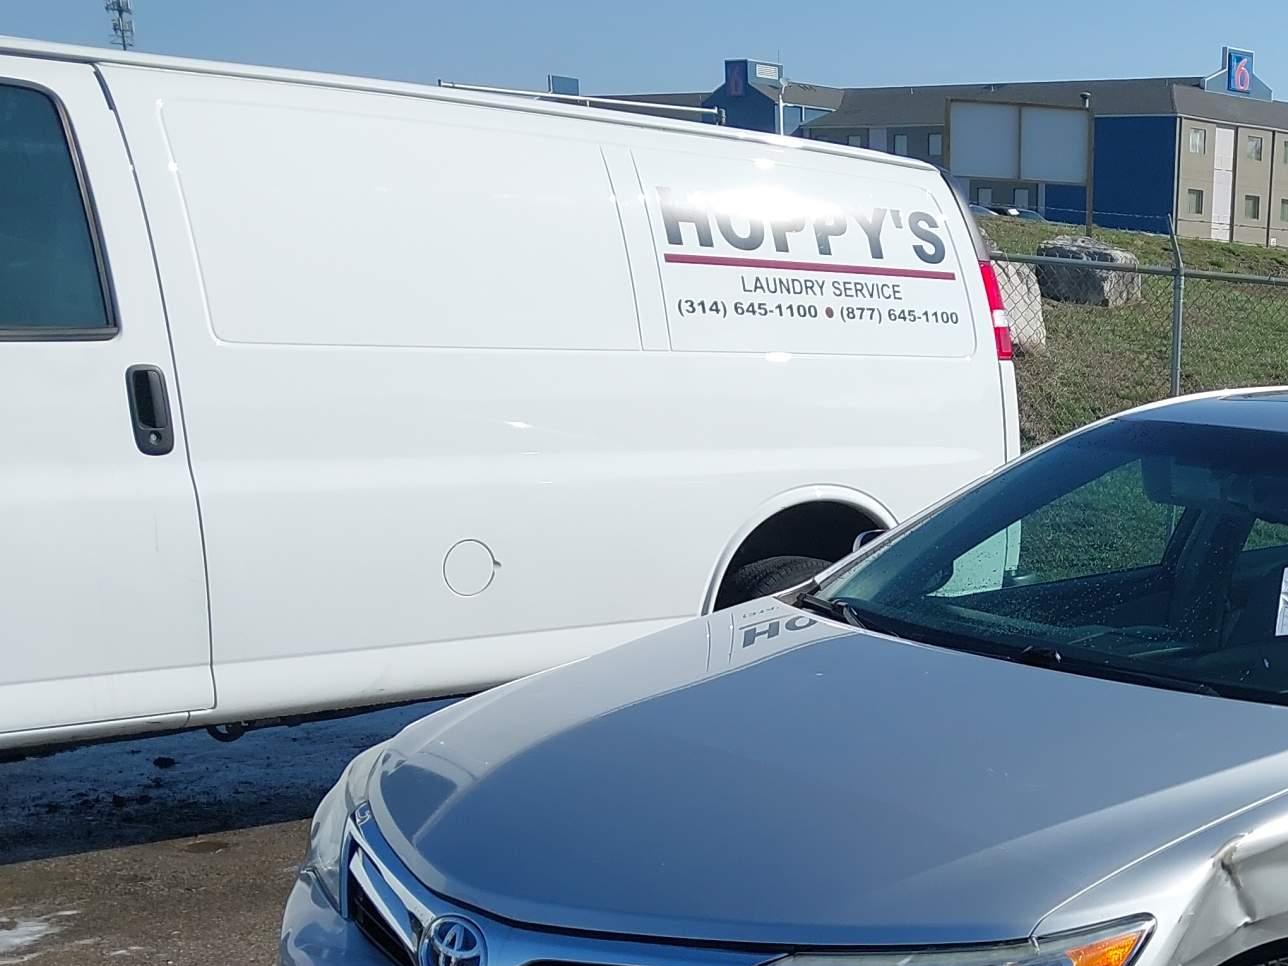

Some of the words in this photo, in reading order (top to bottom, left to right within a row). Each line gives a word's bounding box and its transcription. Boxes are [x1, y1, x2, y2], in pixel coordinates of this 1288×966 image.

[1235, 58, 1249, 91] 6
[656, 186, 946, 264] HOPPY'S
[741, 275, 825, 297] LAUNDRY
[832, 281, 902, 300] SERVICE
[677, 298, 727, 318] (314)
[734, 302, 818, 319] 645-1100
[840, 306, 882, 324] (877)
[887, 308, 959, 325] 645-1100
